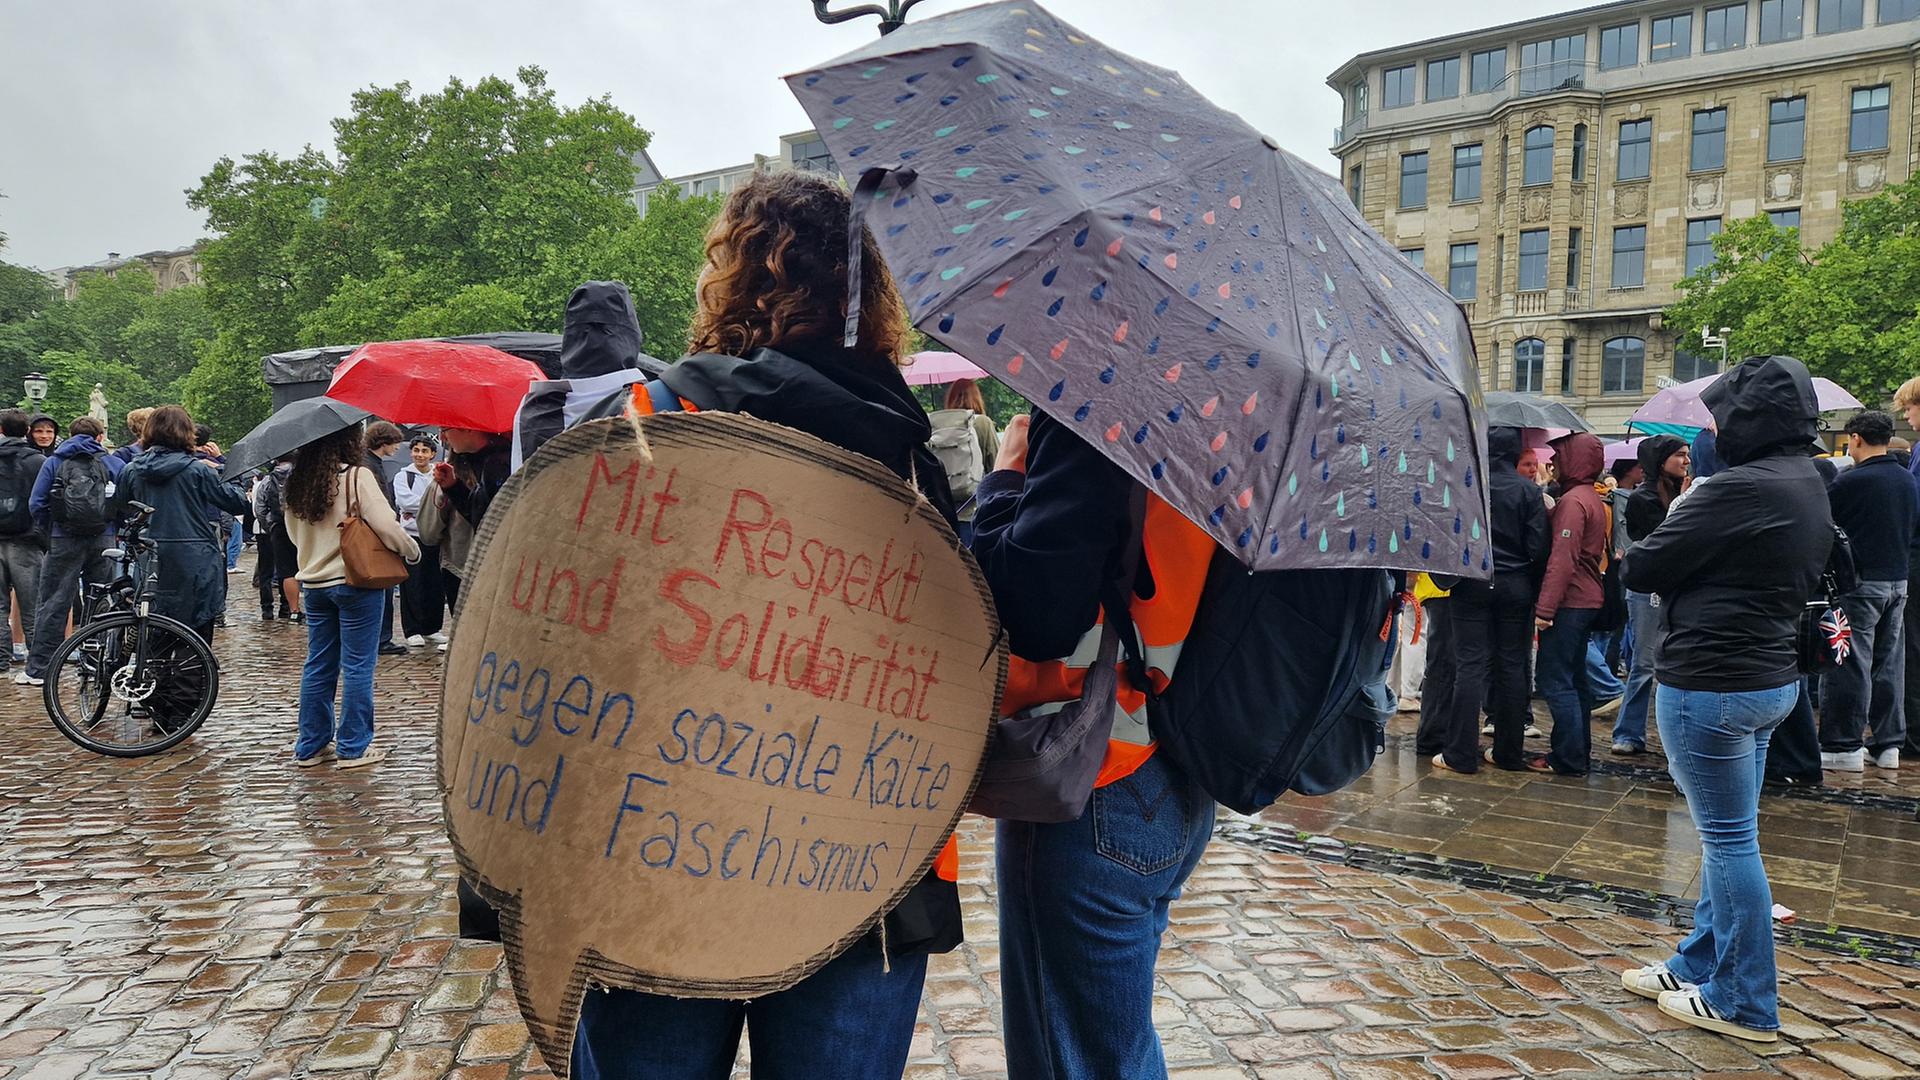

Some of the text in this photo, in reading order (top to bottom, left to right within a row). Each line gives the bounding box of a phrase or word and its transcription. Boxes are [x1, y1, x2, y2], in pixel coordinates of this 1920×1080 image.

[577, 452, 925, 624] Mit Respekt
[511, 555, 939, 721] und Solidarität
[466, 751, 565, 836] und
[469, 651, 635, 748] gegen
[656, 703, 842, 794] soziale
[852, 720, 951, 810] Kälte
